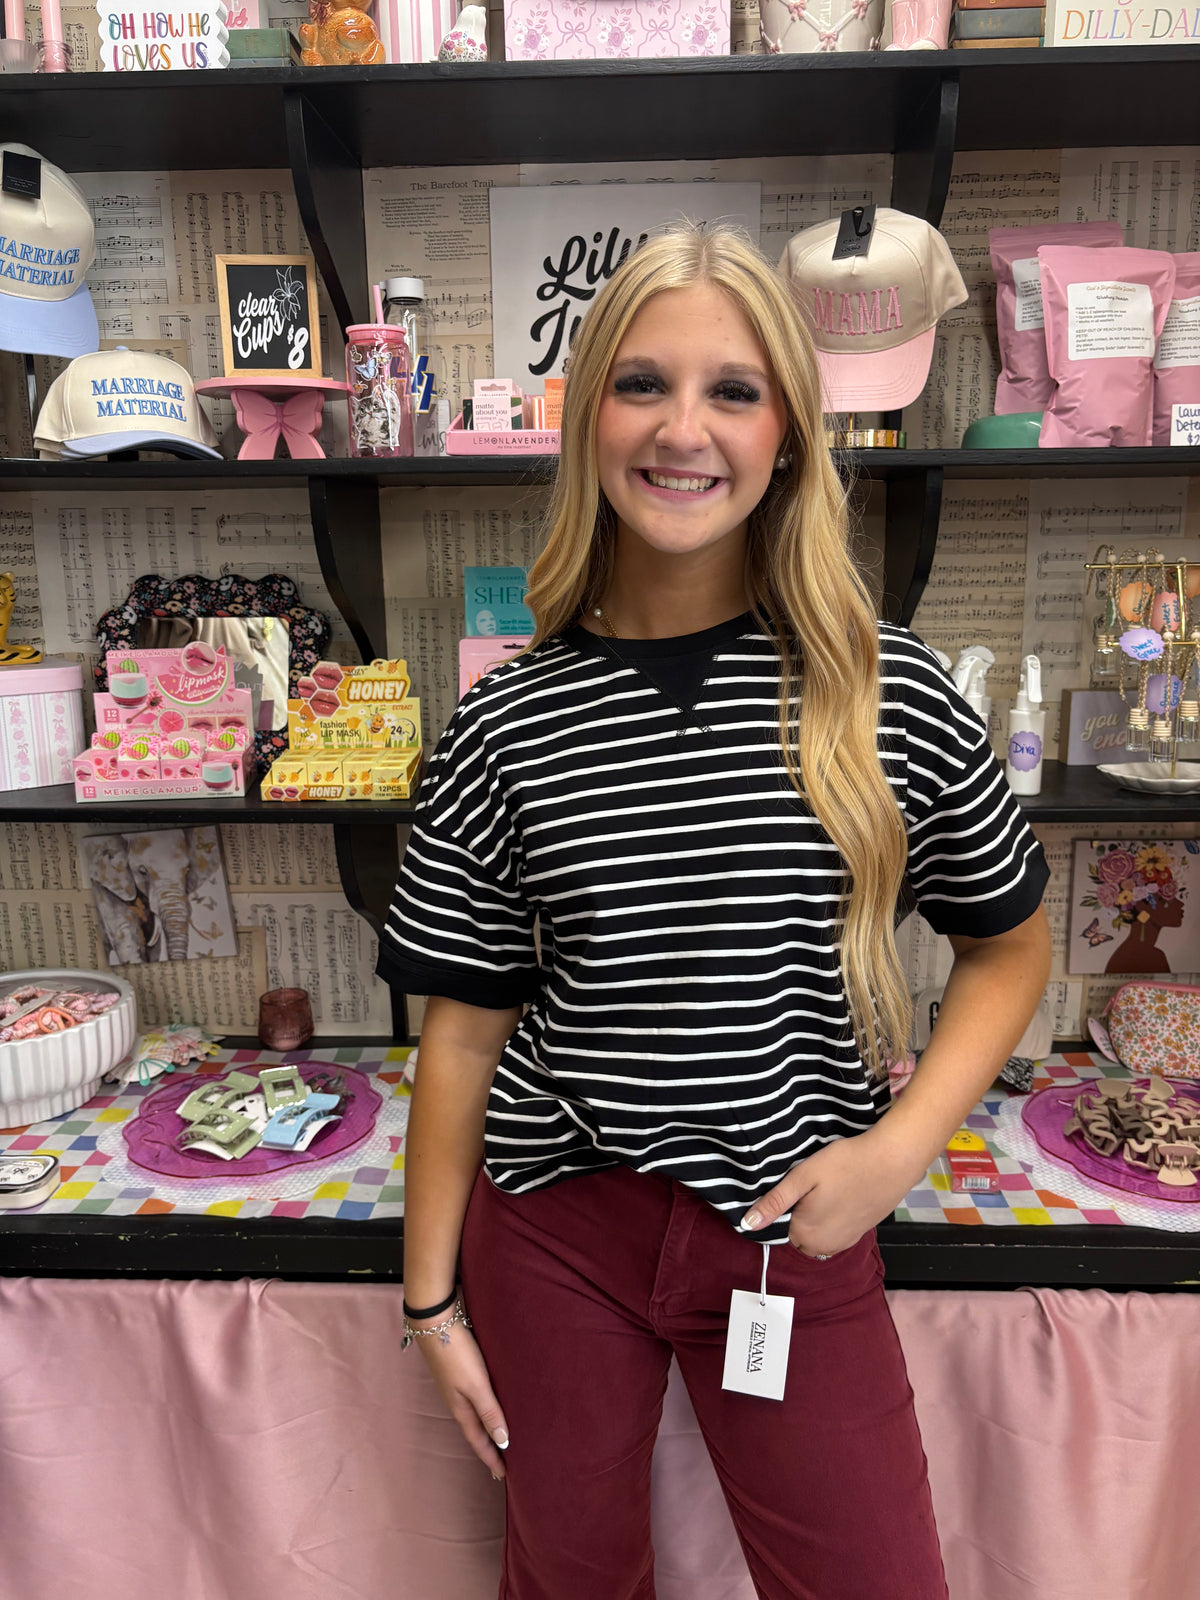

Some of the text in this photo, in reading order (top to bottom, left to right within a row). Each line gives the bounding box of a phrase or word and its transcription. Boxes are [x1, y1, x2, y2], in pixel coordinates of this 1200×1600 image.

[108, 13, 135, 40] OH
[144, 12, 184, 38] HOW
[182, 42, 208, 69] US
[410, 182, 427, 191] The
[431, 180, 468, 190] Barefoot
[238, 291, 279, 318] clear
[812, 286, 904, 337] MAMA
[233, 311, 284, 359] Cups
[91, 376, 185, 401] MARRIAGE
[96, 398, 187, 422] MATERIAL
[475, 408, 508, 417] about you
[348, 681, 406, 701] HONEY
[320, 720, 348, 729] fashion
[320, 728, 361, 738] LIP MASK
[1081, 713, 1119, 742] you
[1012, 741, 1037, 757] Diva
[104, 788, 142, 797] MEIKE
[143, 785, 199, 796] GLAMOUR
[308, 786, 343, 798] HONEY
[750, 1321, 767, 1373] ZENANA
